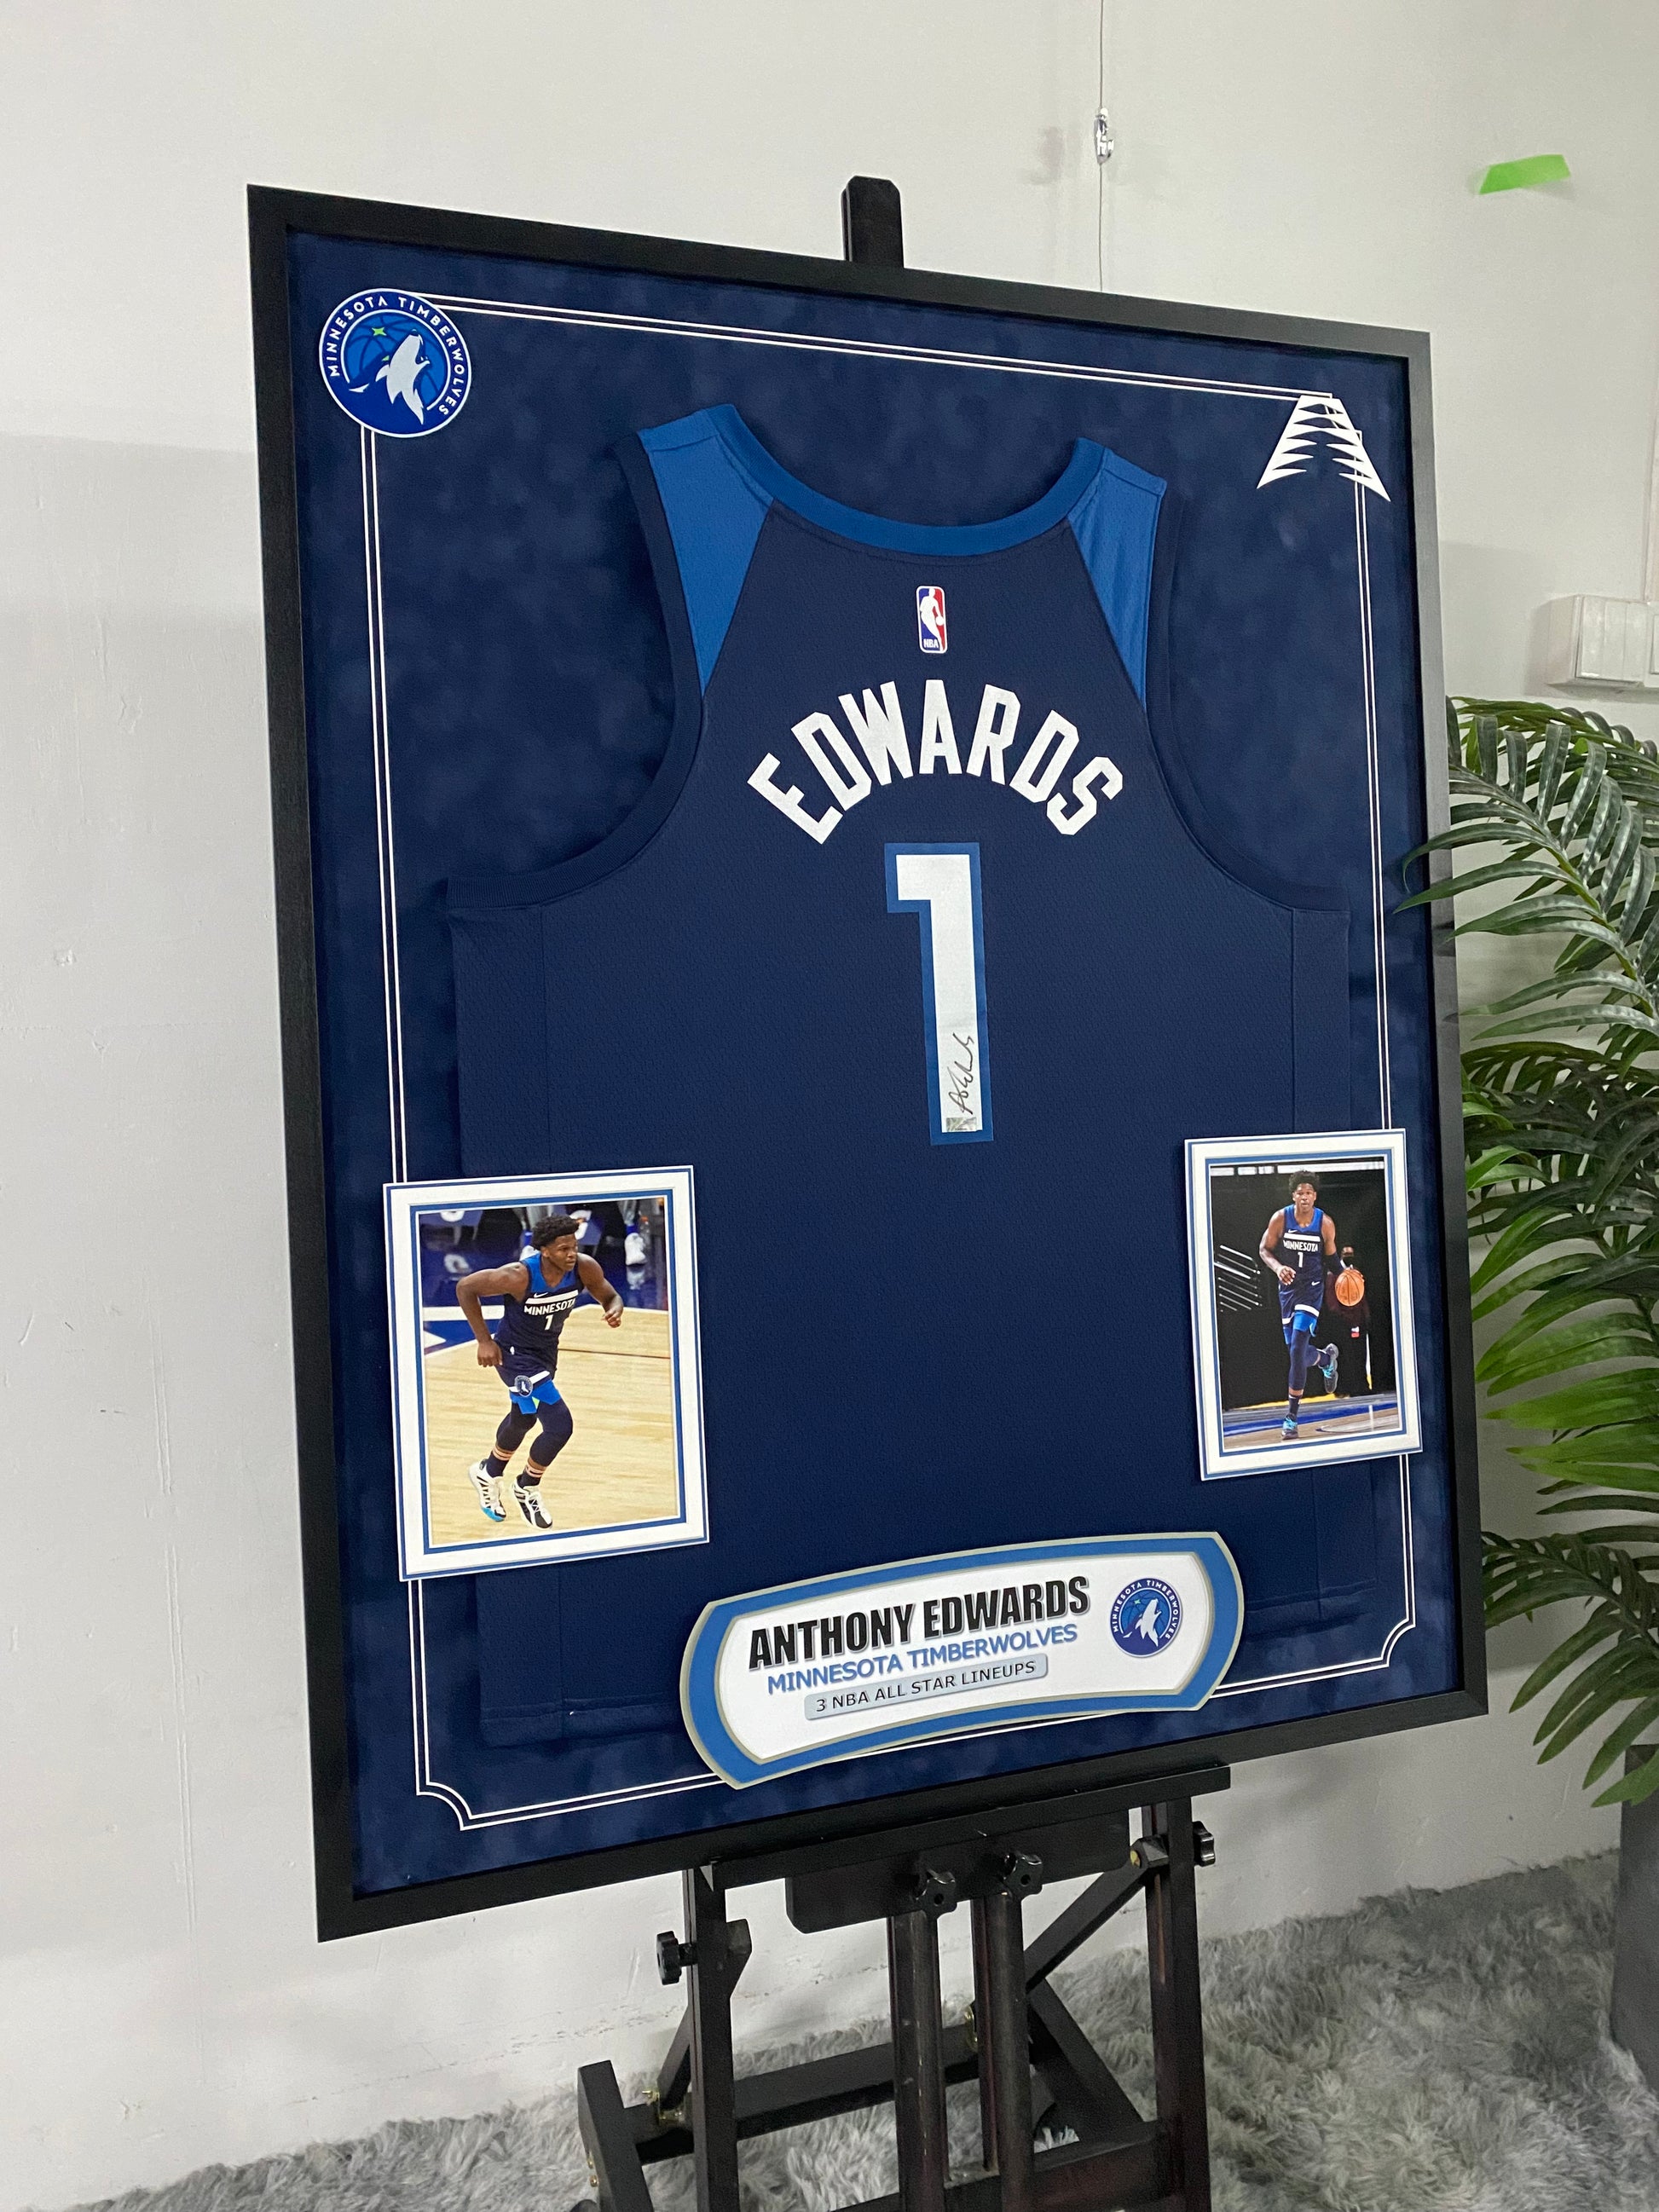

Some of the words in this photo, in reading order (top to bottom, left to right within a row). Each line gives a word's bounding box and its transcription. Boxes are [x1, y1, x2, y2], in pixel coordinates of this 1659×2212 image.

[327, 296, 388, 377] MINNESOTA
[398, 296, 465, 415] TIMBERWOLVES
[923, 638, 939, 649] NBA
[747, 679, 1124, 845] EDWARDS
[885, 842, 993, 1146] 1
[1283, 1239, 1319, 1252] MINNESOTA
[1298, 1251, 1304, 1268] 1
[545, 1314, 553, 1331] 1
[749, 1603, 916, 1672] ANTHONY
[923, 1576, 1091, 1641] EDWARDS
[1112, 1582, 1142, 1632] MINNESOTA
[1146, 1580, 1179, 1639] TIMBERWOLVES
[768, 1654, 904, 1695] MINNESOTA
[907, 1623, 1078, 1669] TIMBERWOLVES
[816, 1699, 826, 1712] 3
[832, 1691, 870, 1709] NBA
[875, 1684, 907, 1701] ALL
[911, 1675, 956, 1695] STAR
[962, 1660, 1036, 1685] LINEUPS
